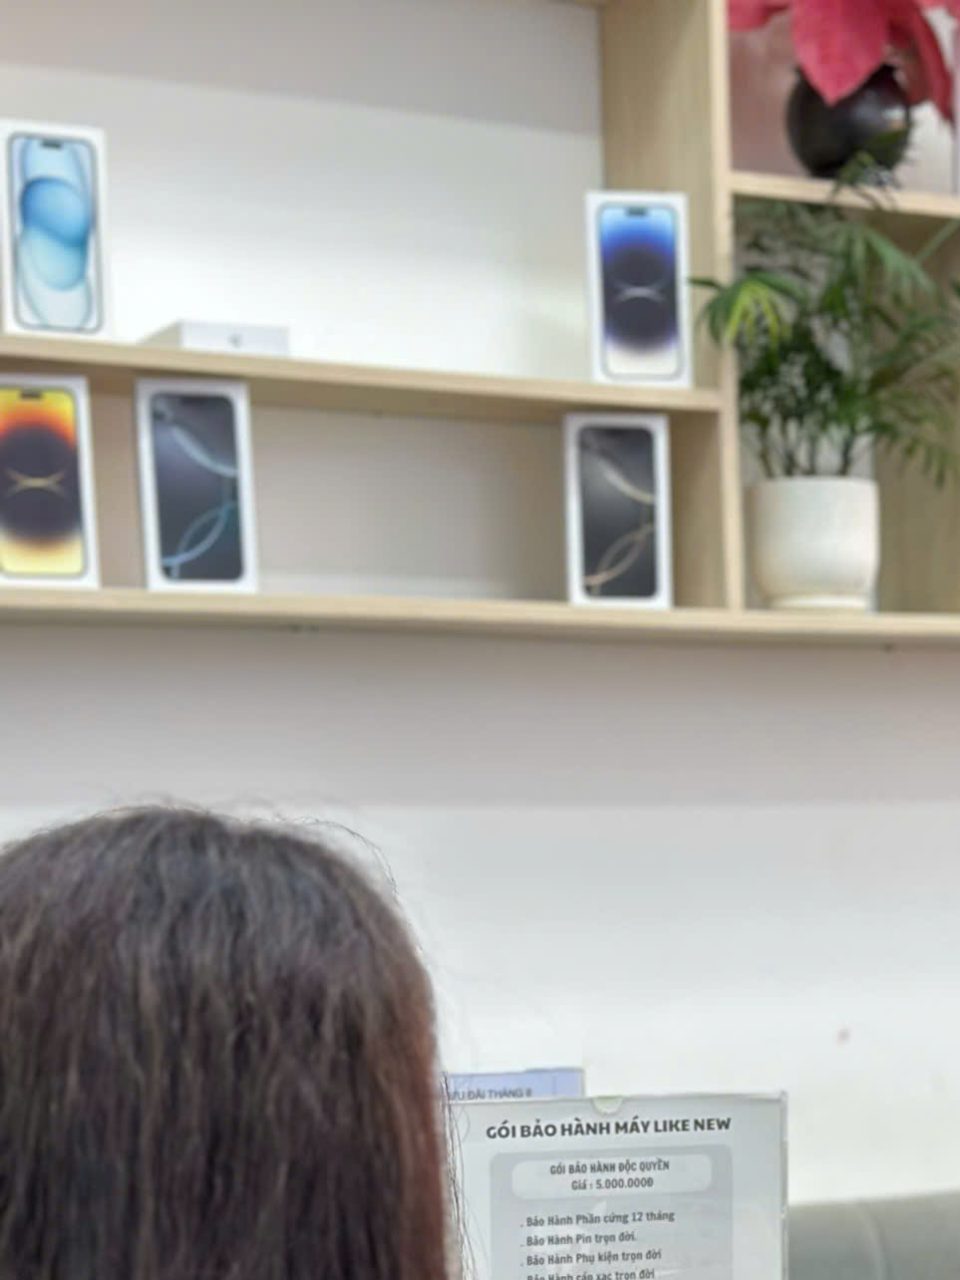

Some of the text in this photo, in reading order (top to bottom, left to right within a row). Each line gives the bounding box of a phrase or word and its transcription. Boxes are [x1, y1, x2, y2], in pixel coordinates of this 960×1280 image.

[486, 1115, 731, 1139] GÓI BẢO HÀNH MÁY LIKE NEW
[550, 1163, 566, 1175] GÓI
[590, 1160, 616, 1173] HÀNH
[618, 1159, 637, 1174] ĐỘC
[639, 1156, 670, 1172] QUYỀN
[547, 1214, 573, 1226] Hành
[576, 1212, 601, 1225] Phần
[632, 1211, 643, 1222] 12
[646, 1209, 675, 1222] tháng
[547, 1233, 573, 1245] Hành
[576, 1233, 592, 1244] Pin
[547, 1253, 573, 1265] Hành
